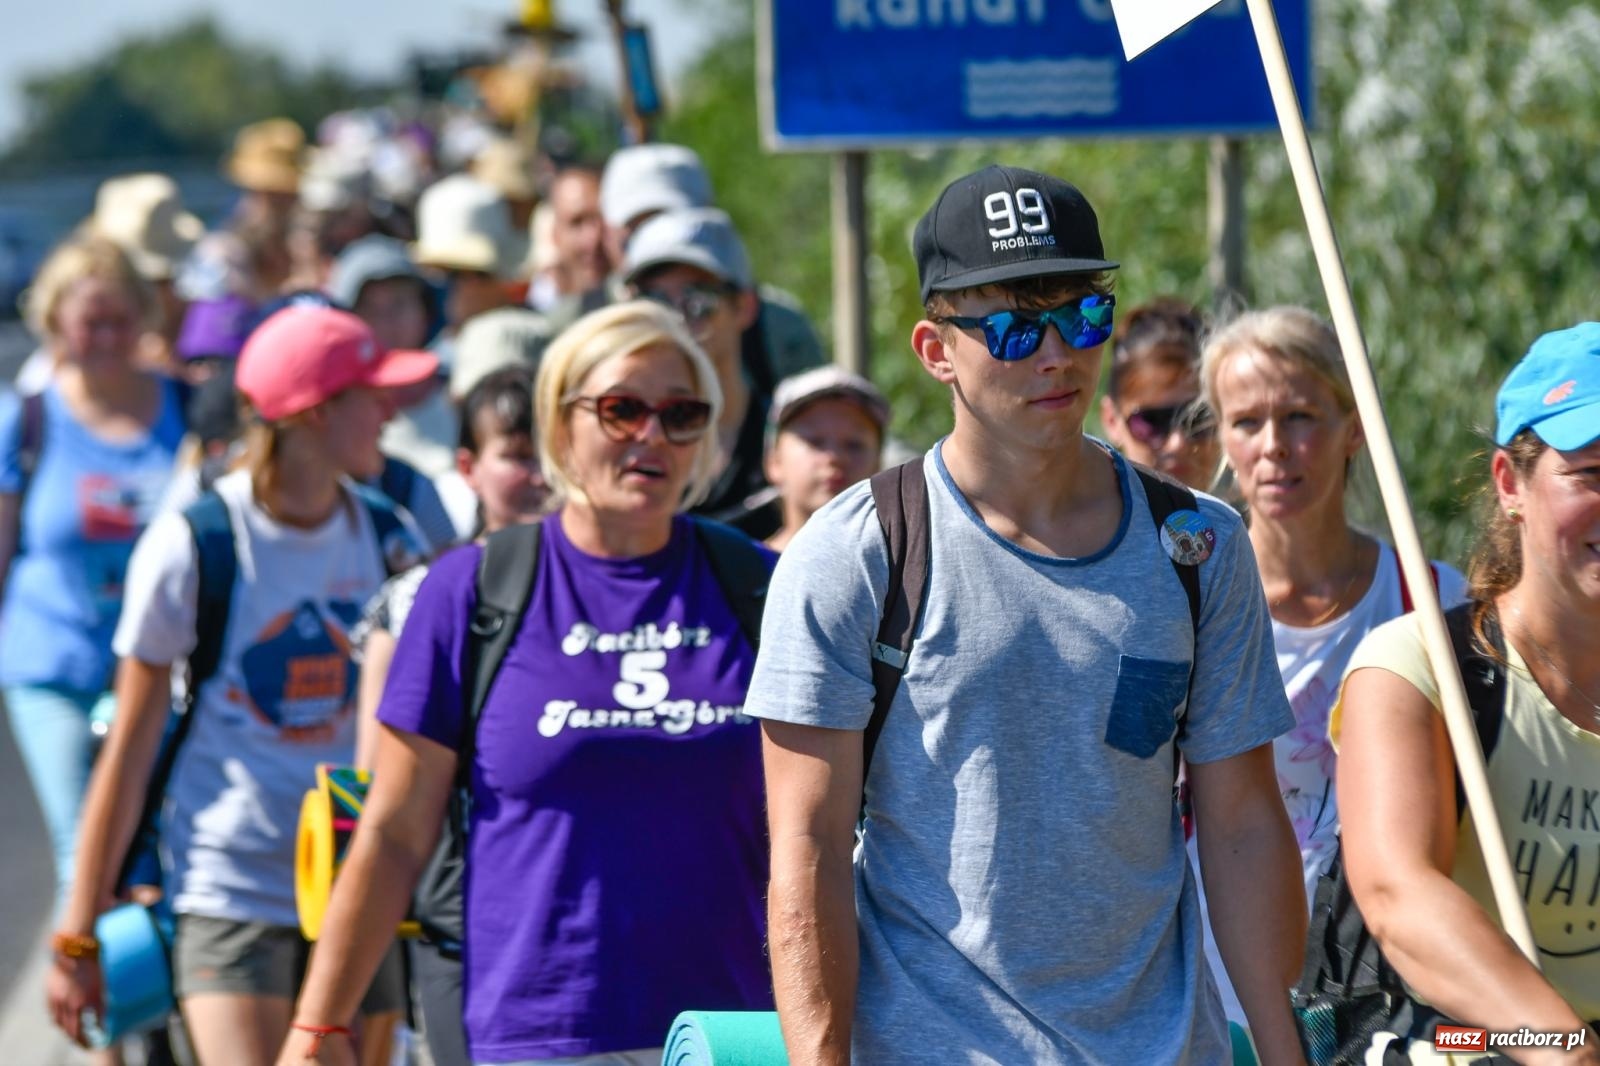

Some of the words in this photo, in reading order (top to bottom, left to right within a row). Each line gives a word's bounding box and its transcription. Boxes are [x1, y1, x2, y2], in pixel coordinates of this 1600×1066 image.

[983, 187, 1051, 239] 99
[991, 234, 1057, 253] PROBLEMS
[612, 649, 670, 710] 5
[537, 699, 656, 738] Jasna
[1514, 838, 1600, 907] HA
